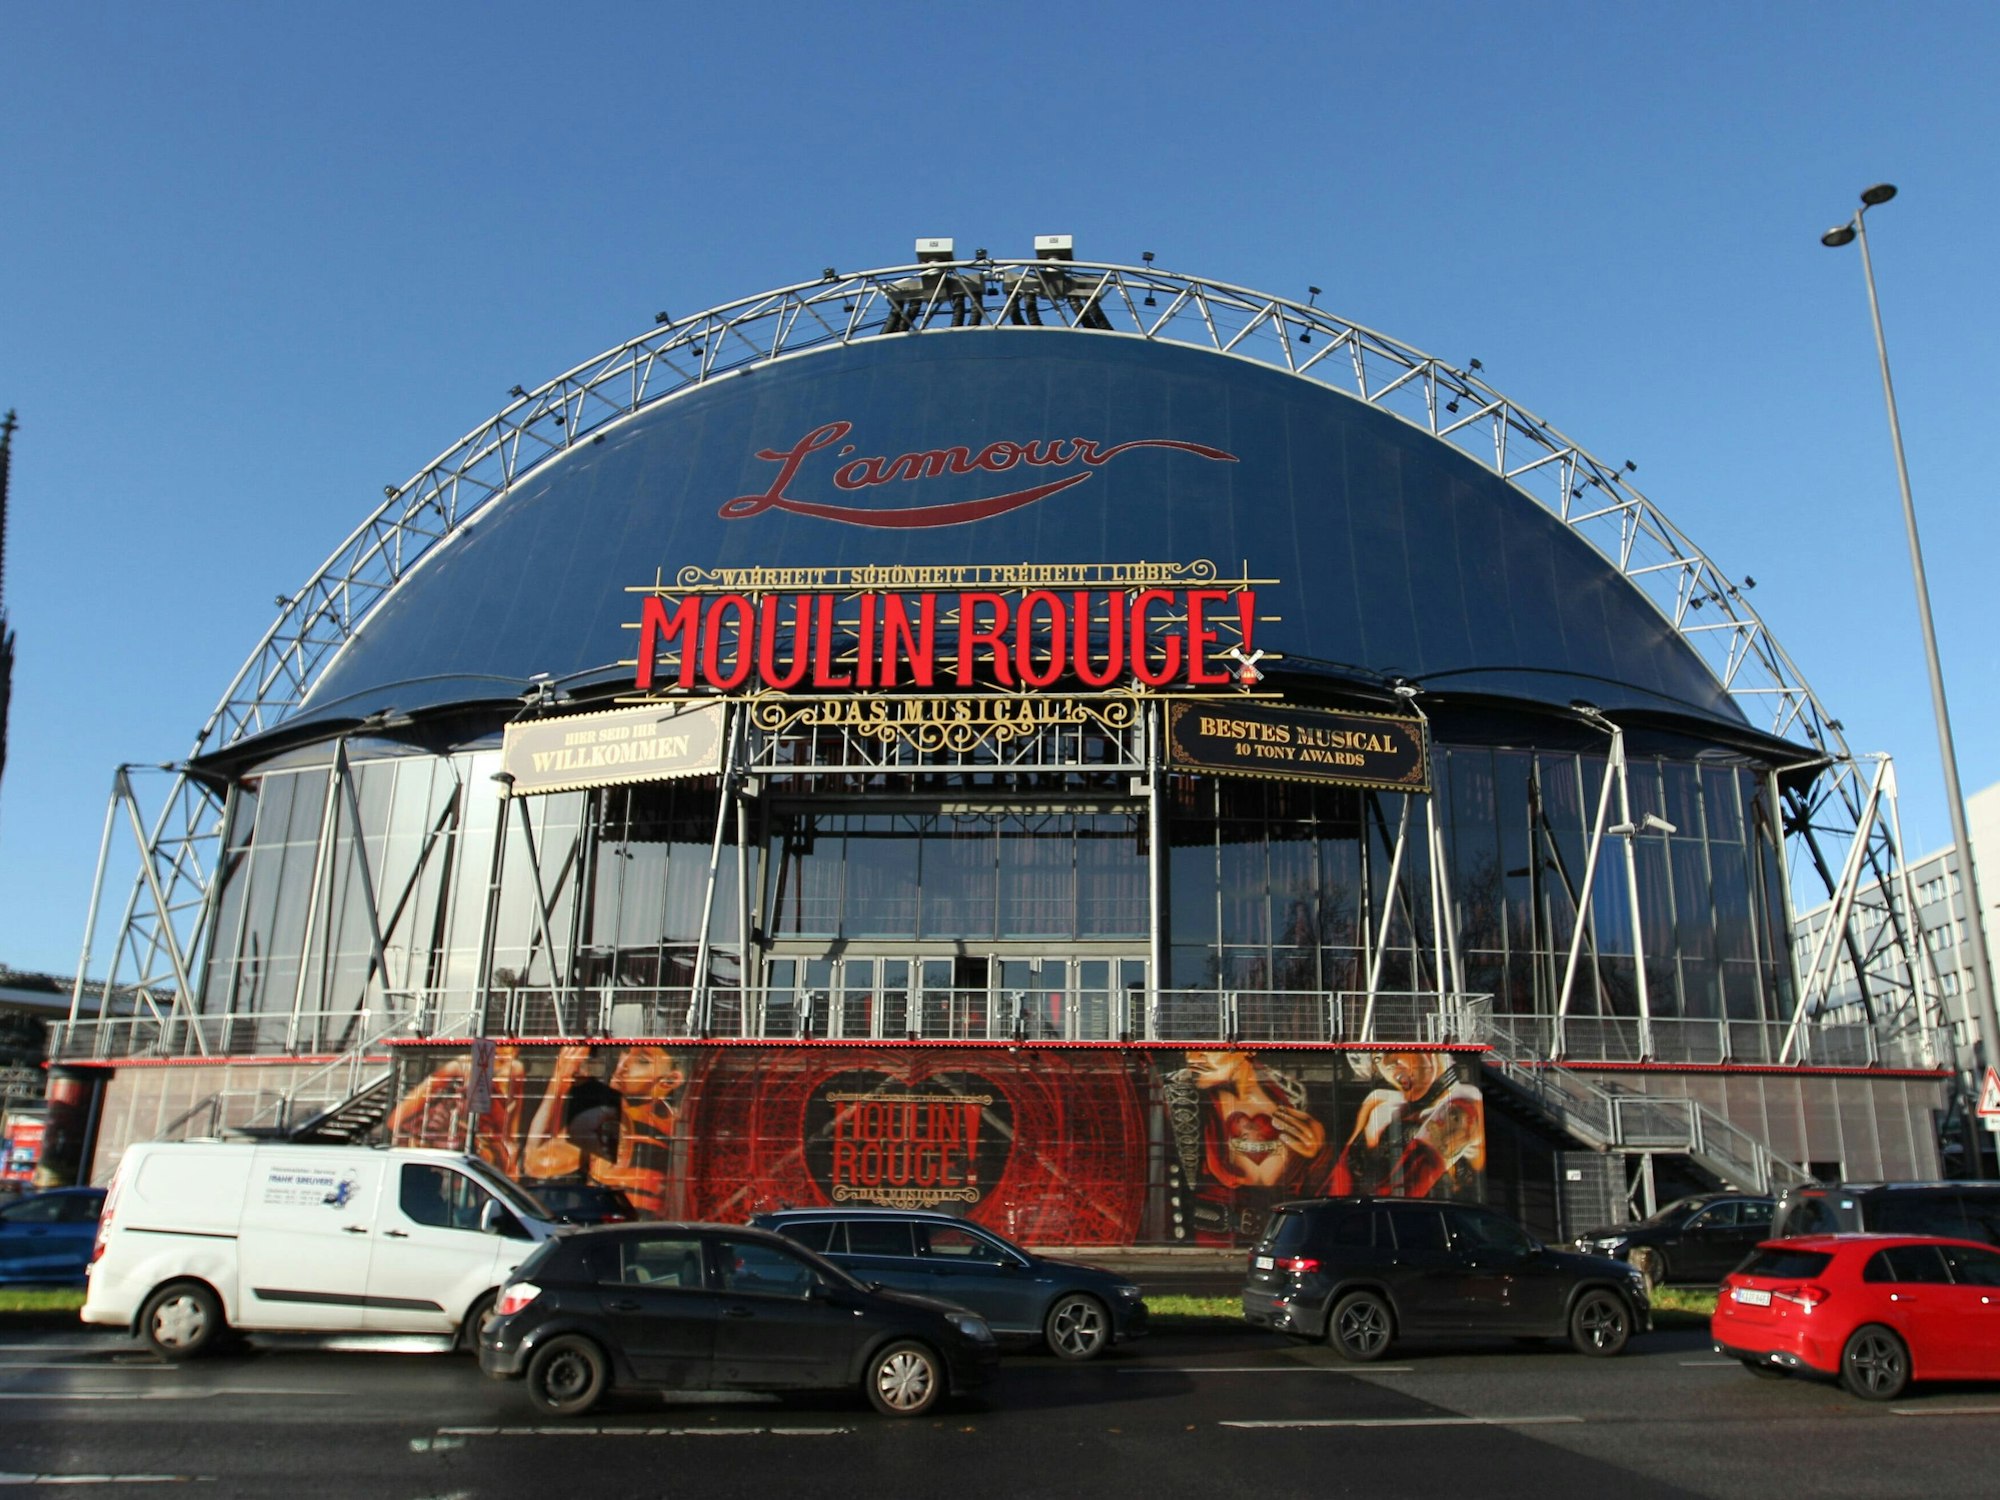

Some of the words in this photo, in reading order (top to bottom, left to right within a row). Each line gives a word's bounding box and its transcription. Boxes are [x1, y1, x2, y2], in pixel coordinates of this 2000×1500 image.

[718, 420, 1240, 528] L'amour
[721, 568, 827, 585] WAHRHEIT
[851, 564, 966, 584] SCHÖNHEIT
[990, 565, 1088, 582] FREIHEIT
[1112, 564, 1173, 581] LIEBE
[635, 593, 937, 689] MOULIN
[955, 589, 1258, 687] ROUGE!
[823, 700, 887, 722] DAS
[903, 699, 1074, 721] MUSICAL!
[565, 730, 597, 746] HIER
[598, 726, 628, 742] SEID
[632, 722, 658, 739] IHR
[1199, 716, 1291, 744] BESTES
[1297, 726, 1398, 754] MUSICAL
[532, 734, 691, 772] WILLKOMMEN
[1234, 742, 1251, 756] 10
[1254, 745, 1296, 761] TONY
[1299, 750, 1365, 767] AWARDS
[834, 1101, 961, 1142] MOULIN
[859, 1189, 884, 1200] DAS
